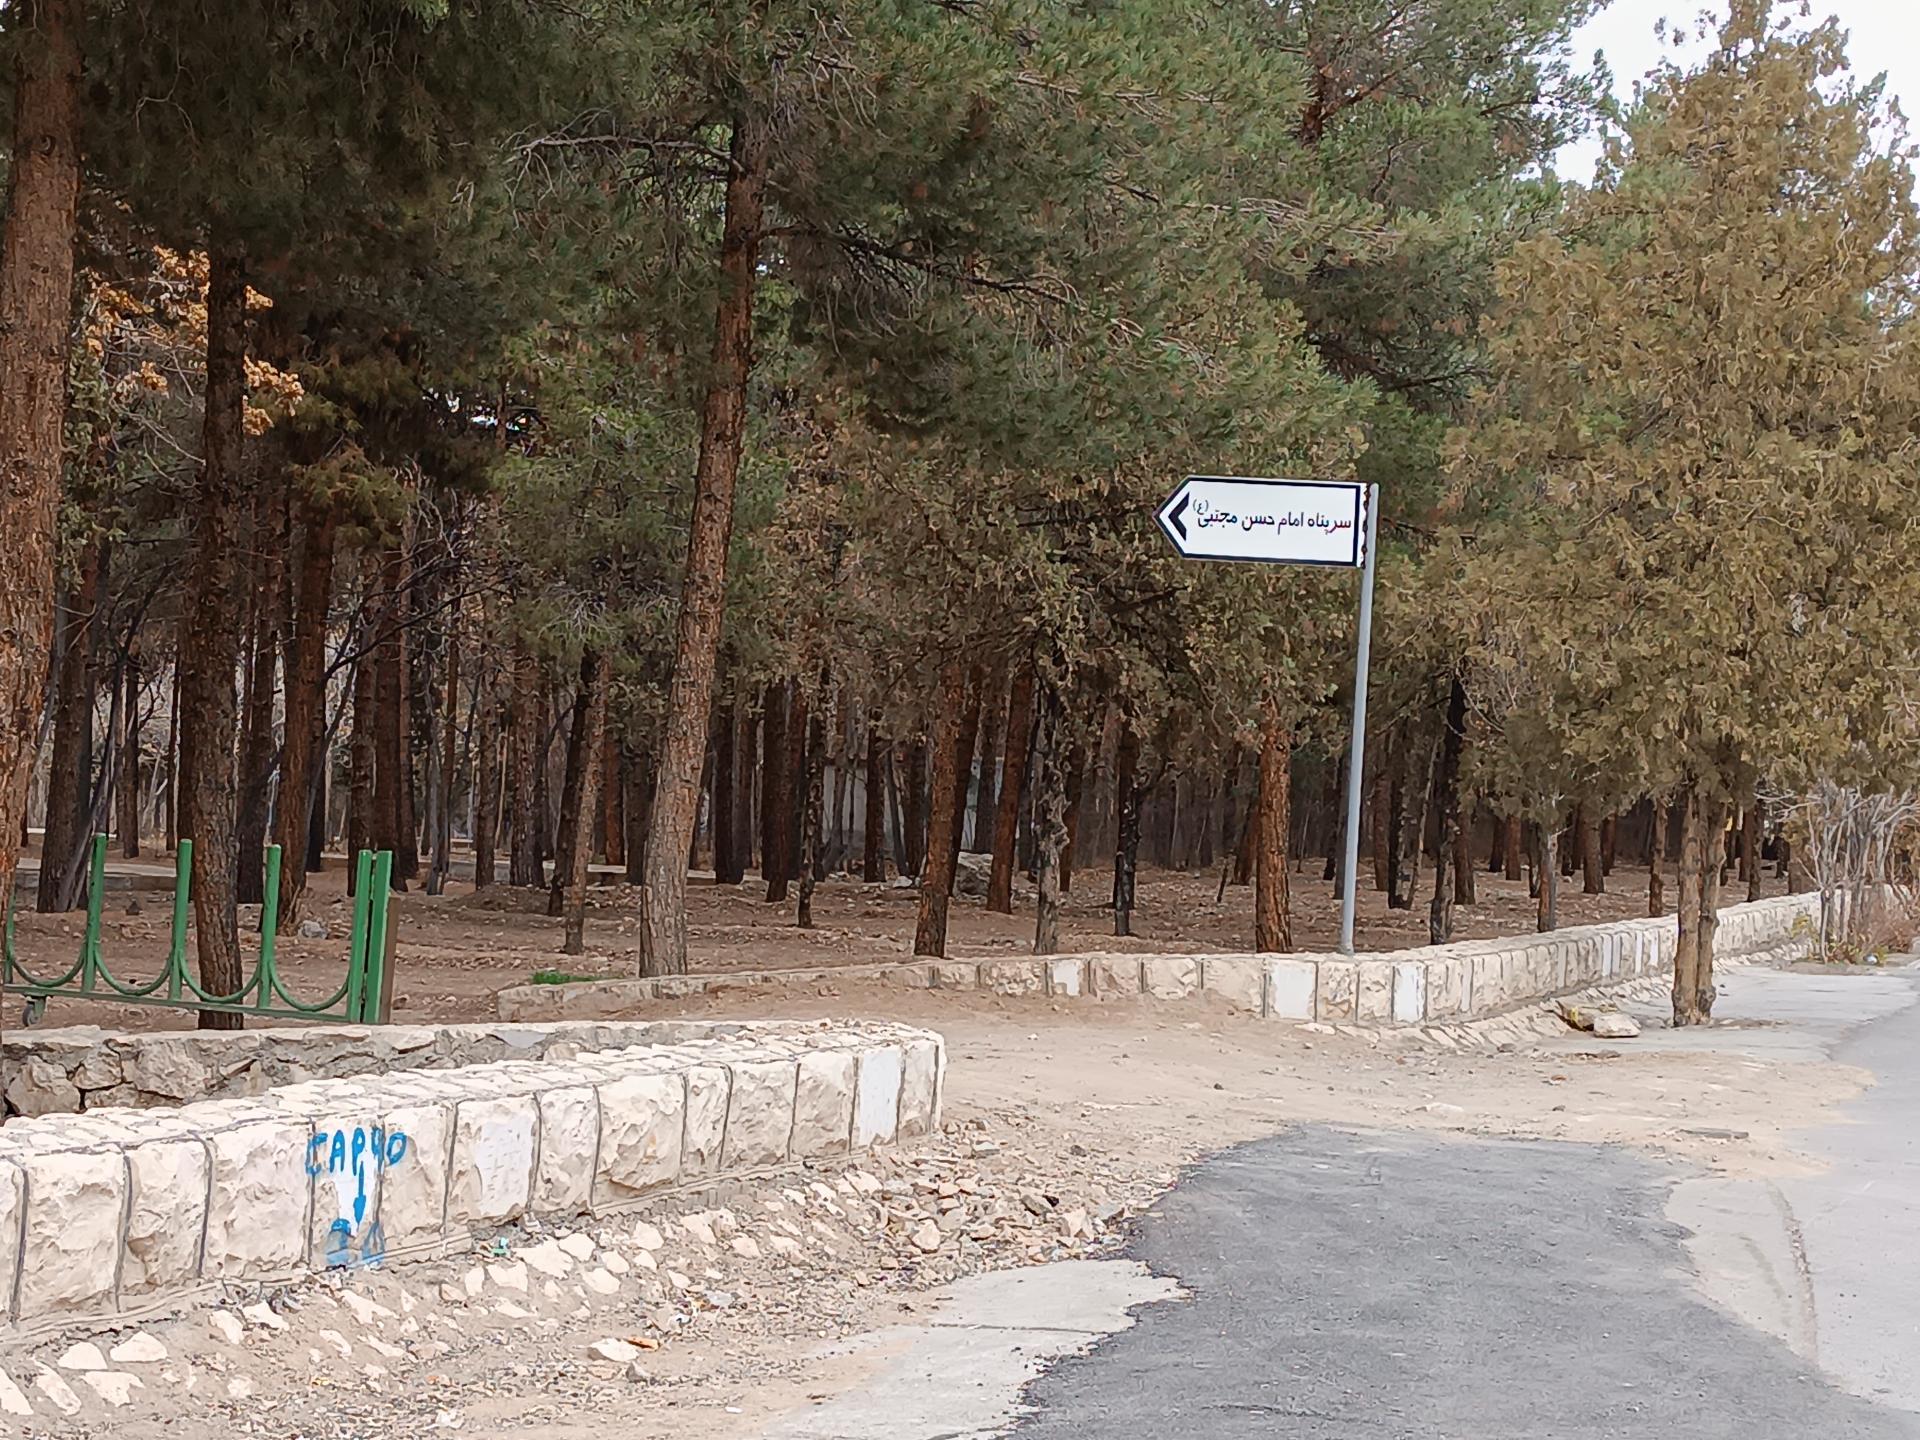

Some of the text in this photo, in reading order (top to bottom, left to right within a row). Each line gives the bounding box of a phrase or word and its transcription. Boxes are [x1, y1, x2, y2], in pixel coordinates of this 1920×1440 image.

[1241, 515, 1275, 531] حسن
[1277, 511, 1304, 535] امام
[1307, 512, 1352, 535] سرپناه
